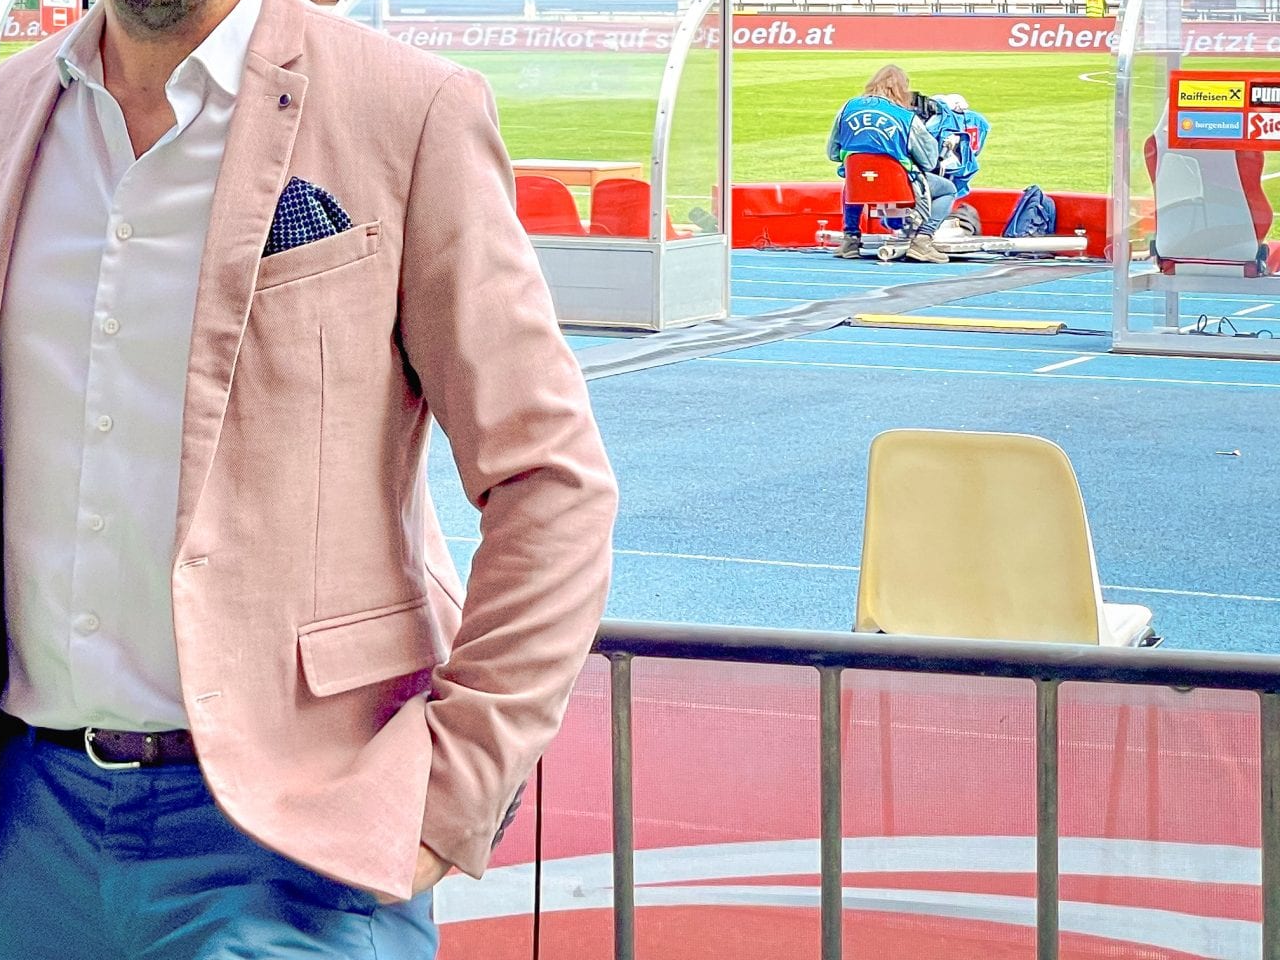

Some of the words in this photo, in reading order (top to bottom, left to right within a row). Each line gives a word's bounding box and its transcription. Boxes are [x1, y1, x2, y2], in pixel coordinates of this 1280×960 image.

[398, 26, 453, 46] dein
[462, 24, 518, 47] ÖFB
[524, 26, 594, 48] Trikot
[602, 27, 649, 49] auf
[1008, 22, 1121, 49] Sichere
[1182, 29, 1256, 56] jetzt
[1180, 92, 1228, 101] Raiffeisen
[848, 113, 898, 140] UEFA
[1195, 121, 1240, 130] burgenland
